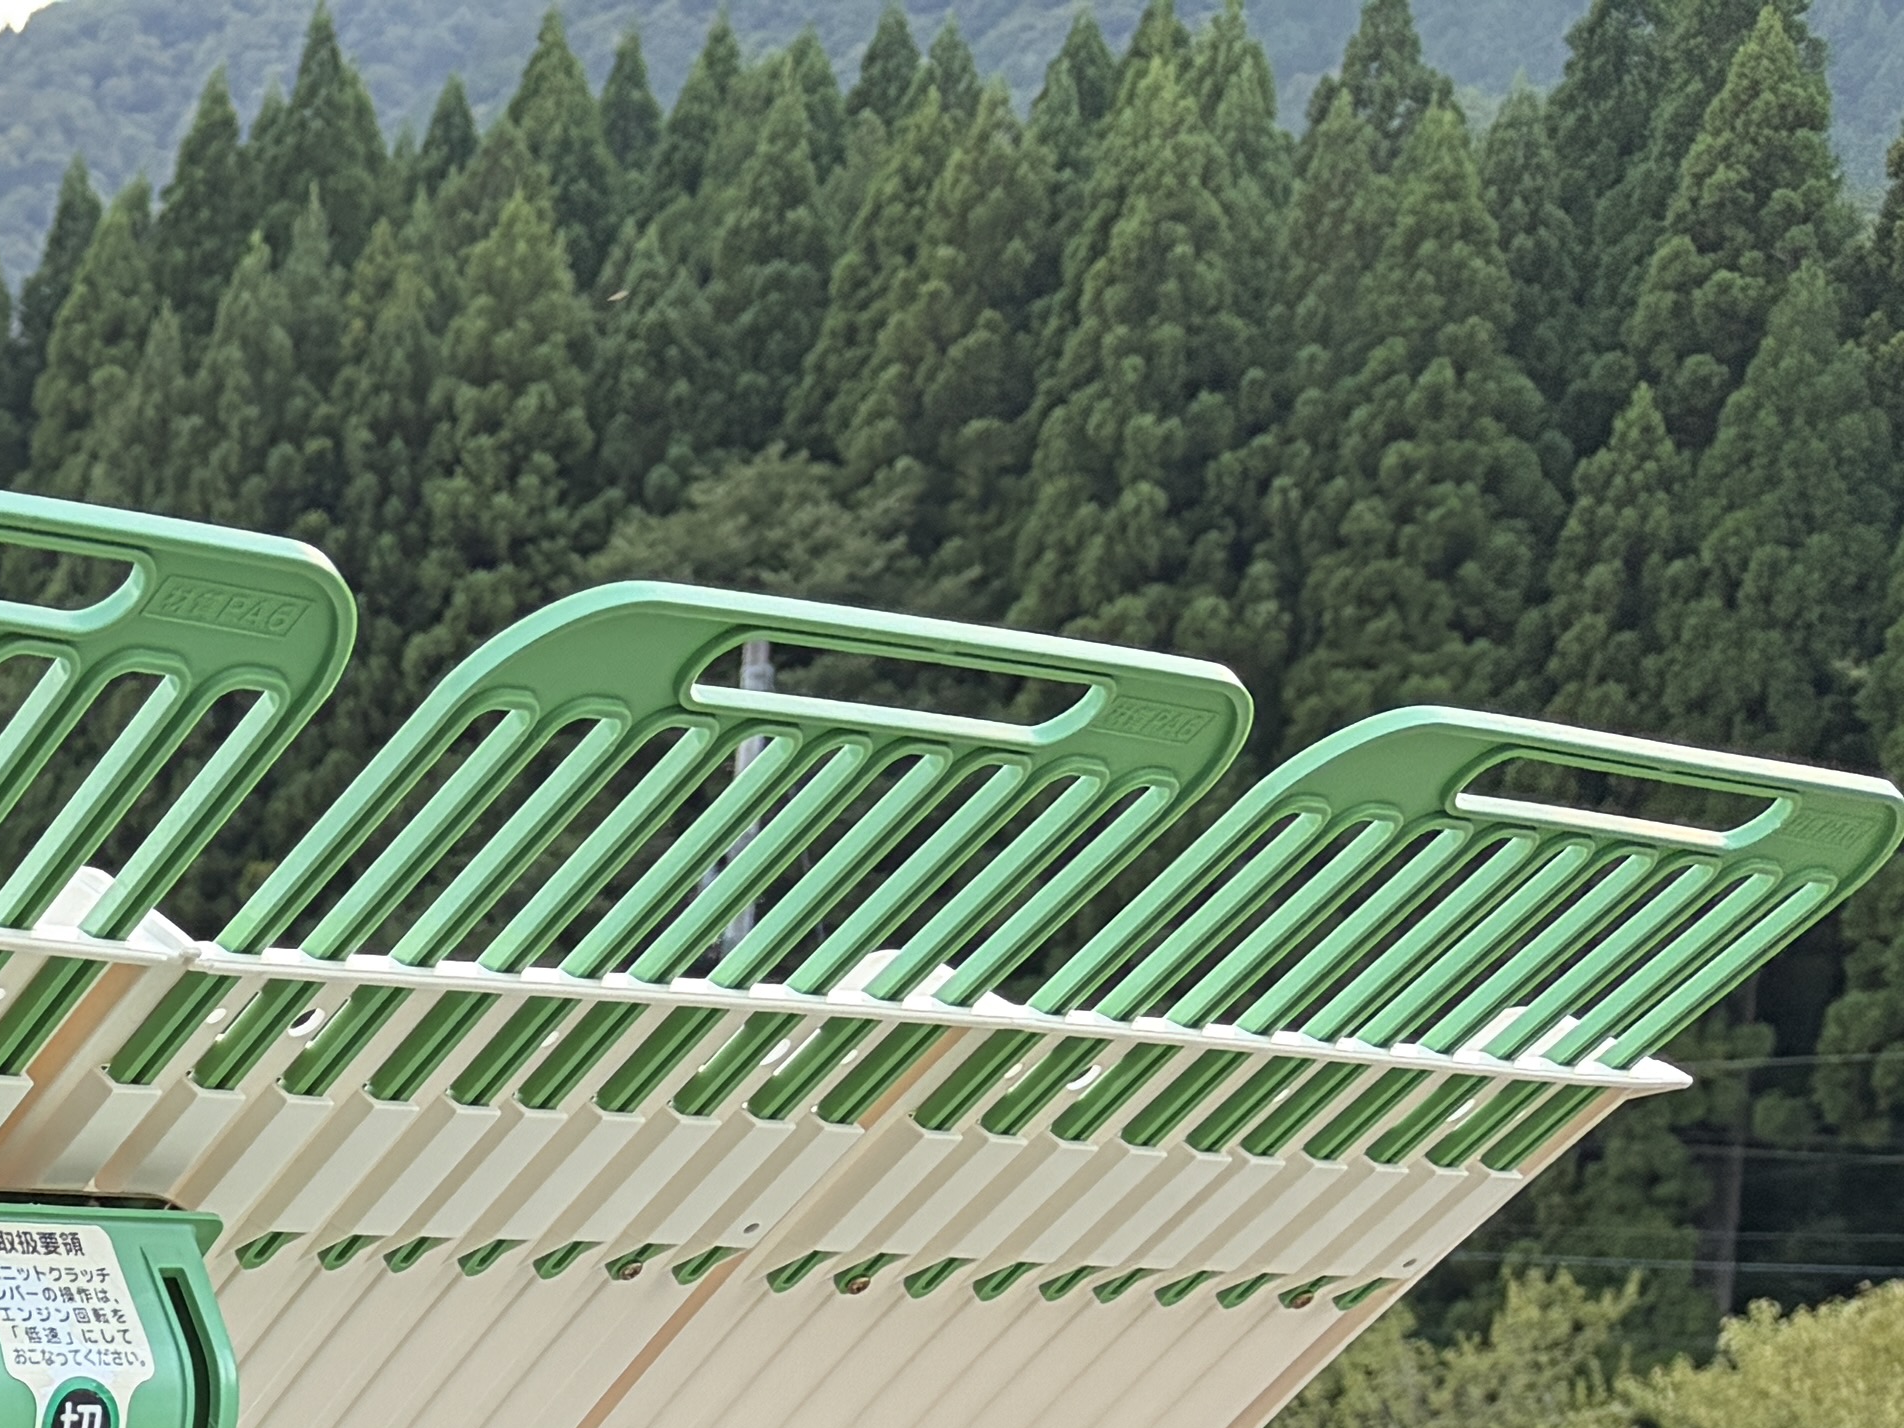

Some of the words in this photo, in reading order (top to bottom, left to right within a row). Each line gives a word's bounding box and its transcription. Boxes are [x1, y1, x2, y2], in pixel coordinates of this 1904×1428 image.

[11, 1326, 133, 1346] 「低速」にして
[13, 1348, 147, 1368] おこなってください。
